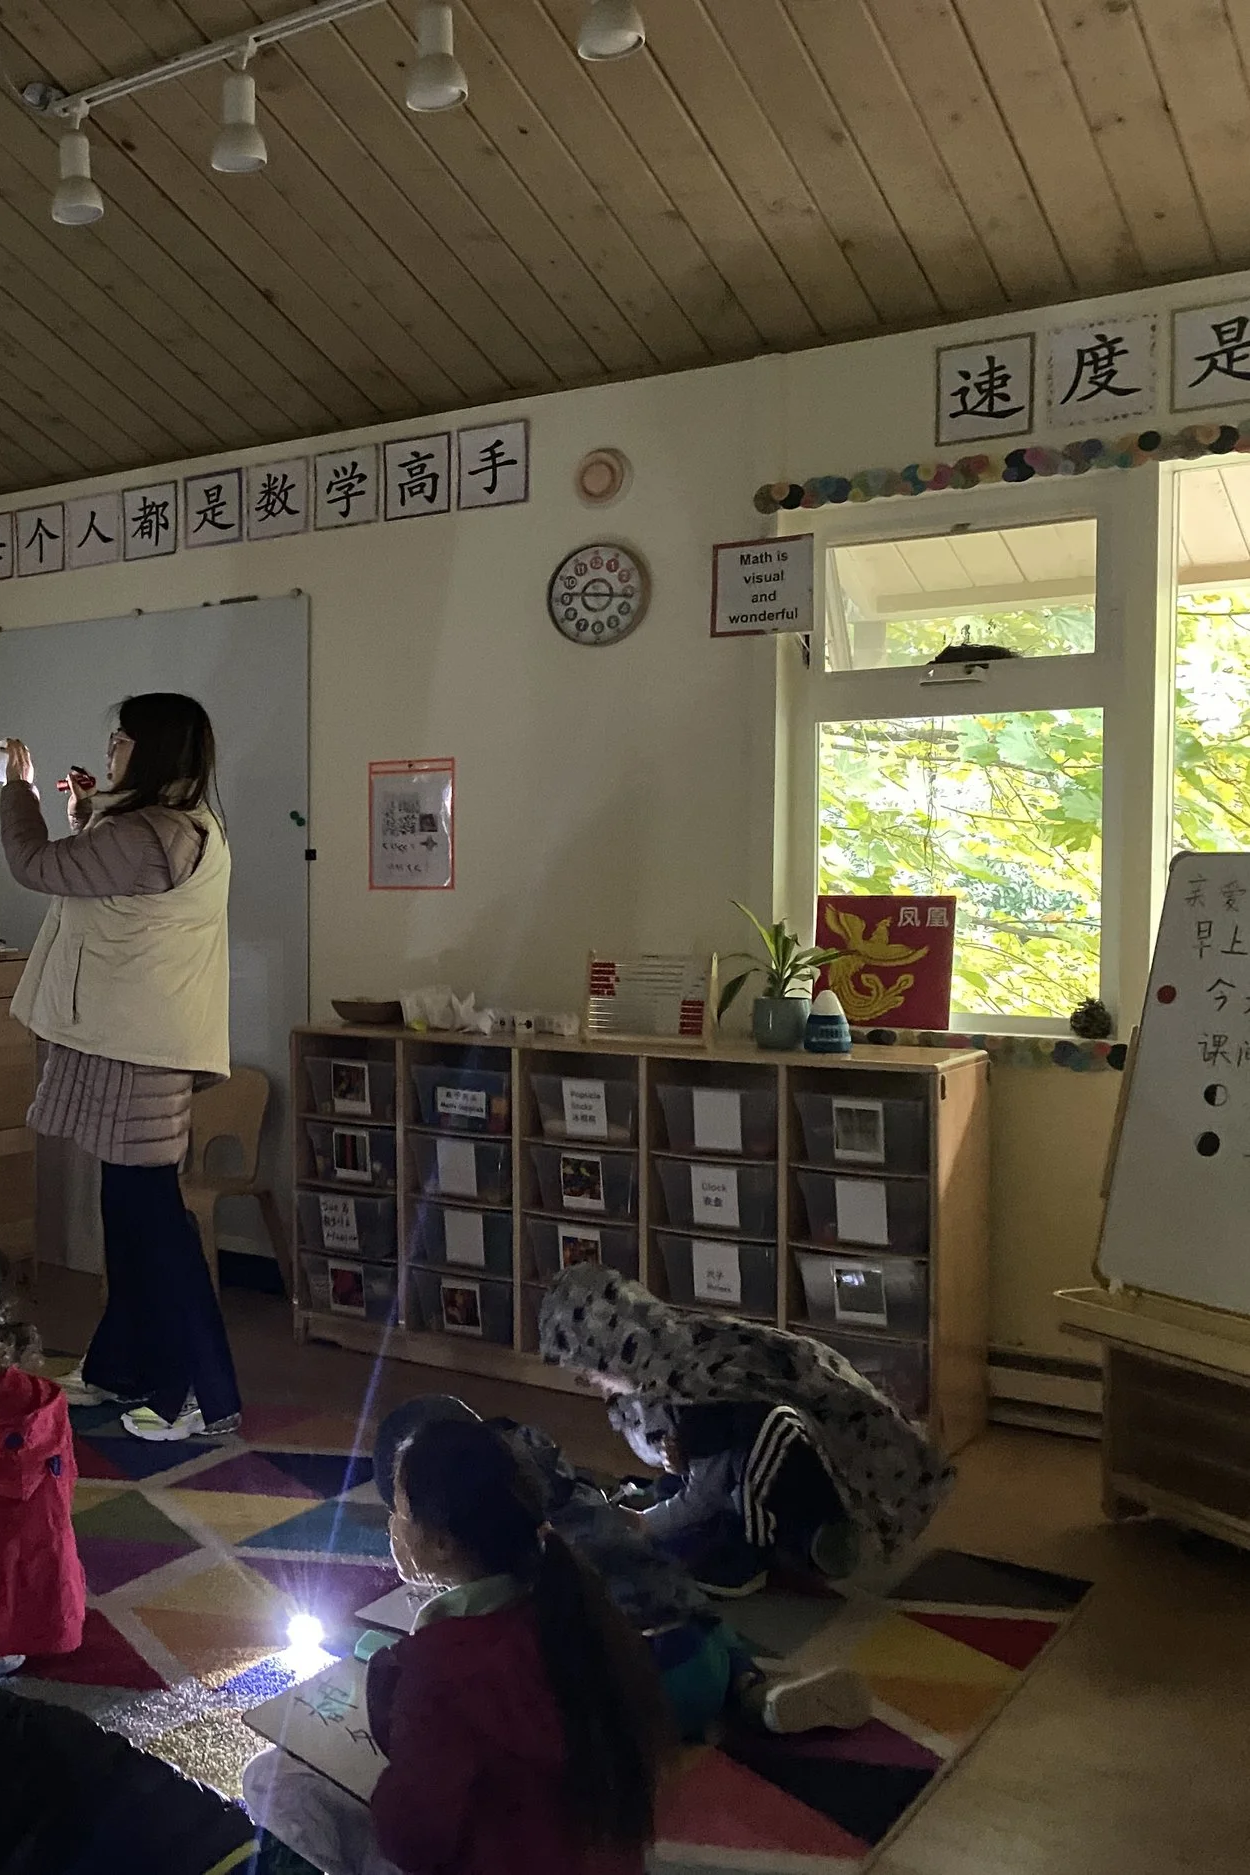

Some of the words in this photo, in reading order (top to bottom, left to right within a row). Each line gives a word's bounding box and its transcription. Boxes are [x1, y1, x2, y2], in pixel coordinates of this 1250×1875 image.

[739, 551, 772, 566] Math
[777, 550, 789, 562] is
[743, 569, 784, 584] visual
[751, 590, 777, 604] and
[728, 607, 798, 624] wonderful
[897, 906, 949, 927] 凤凰
[1192, 920, 1249, 959] 早上
